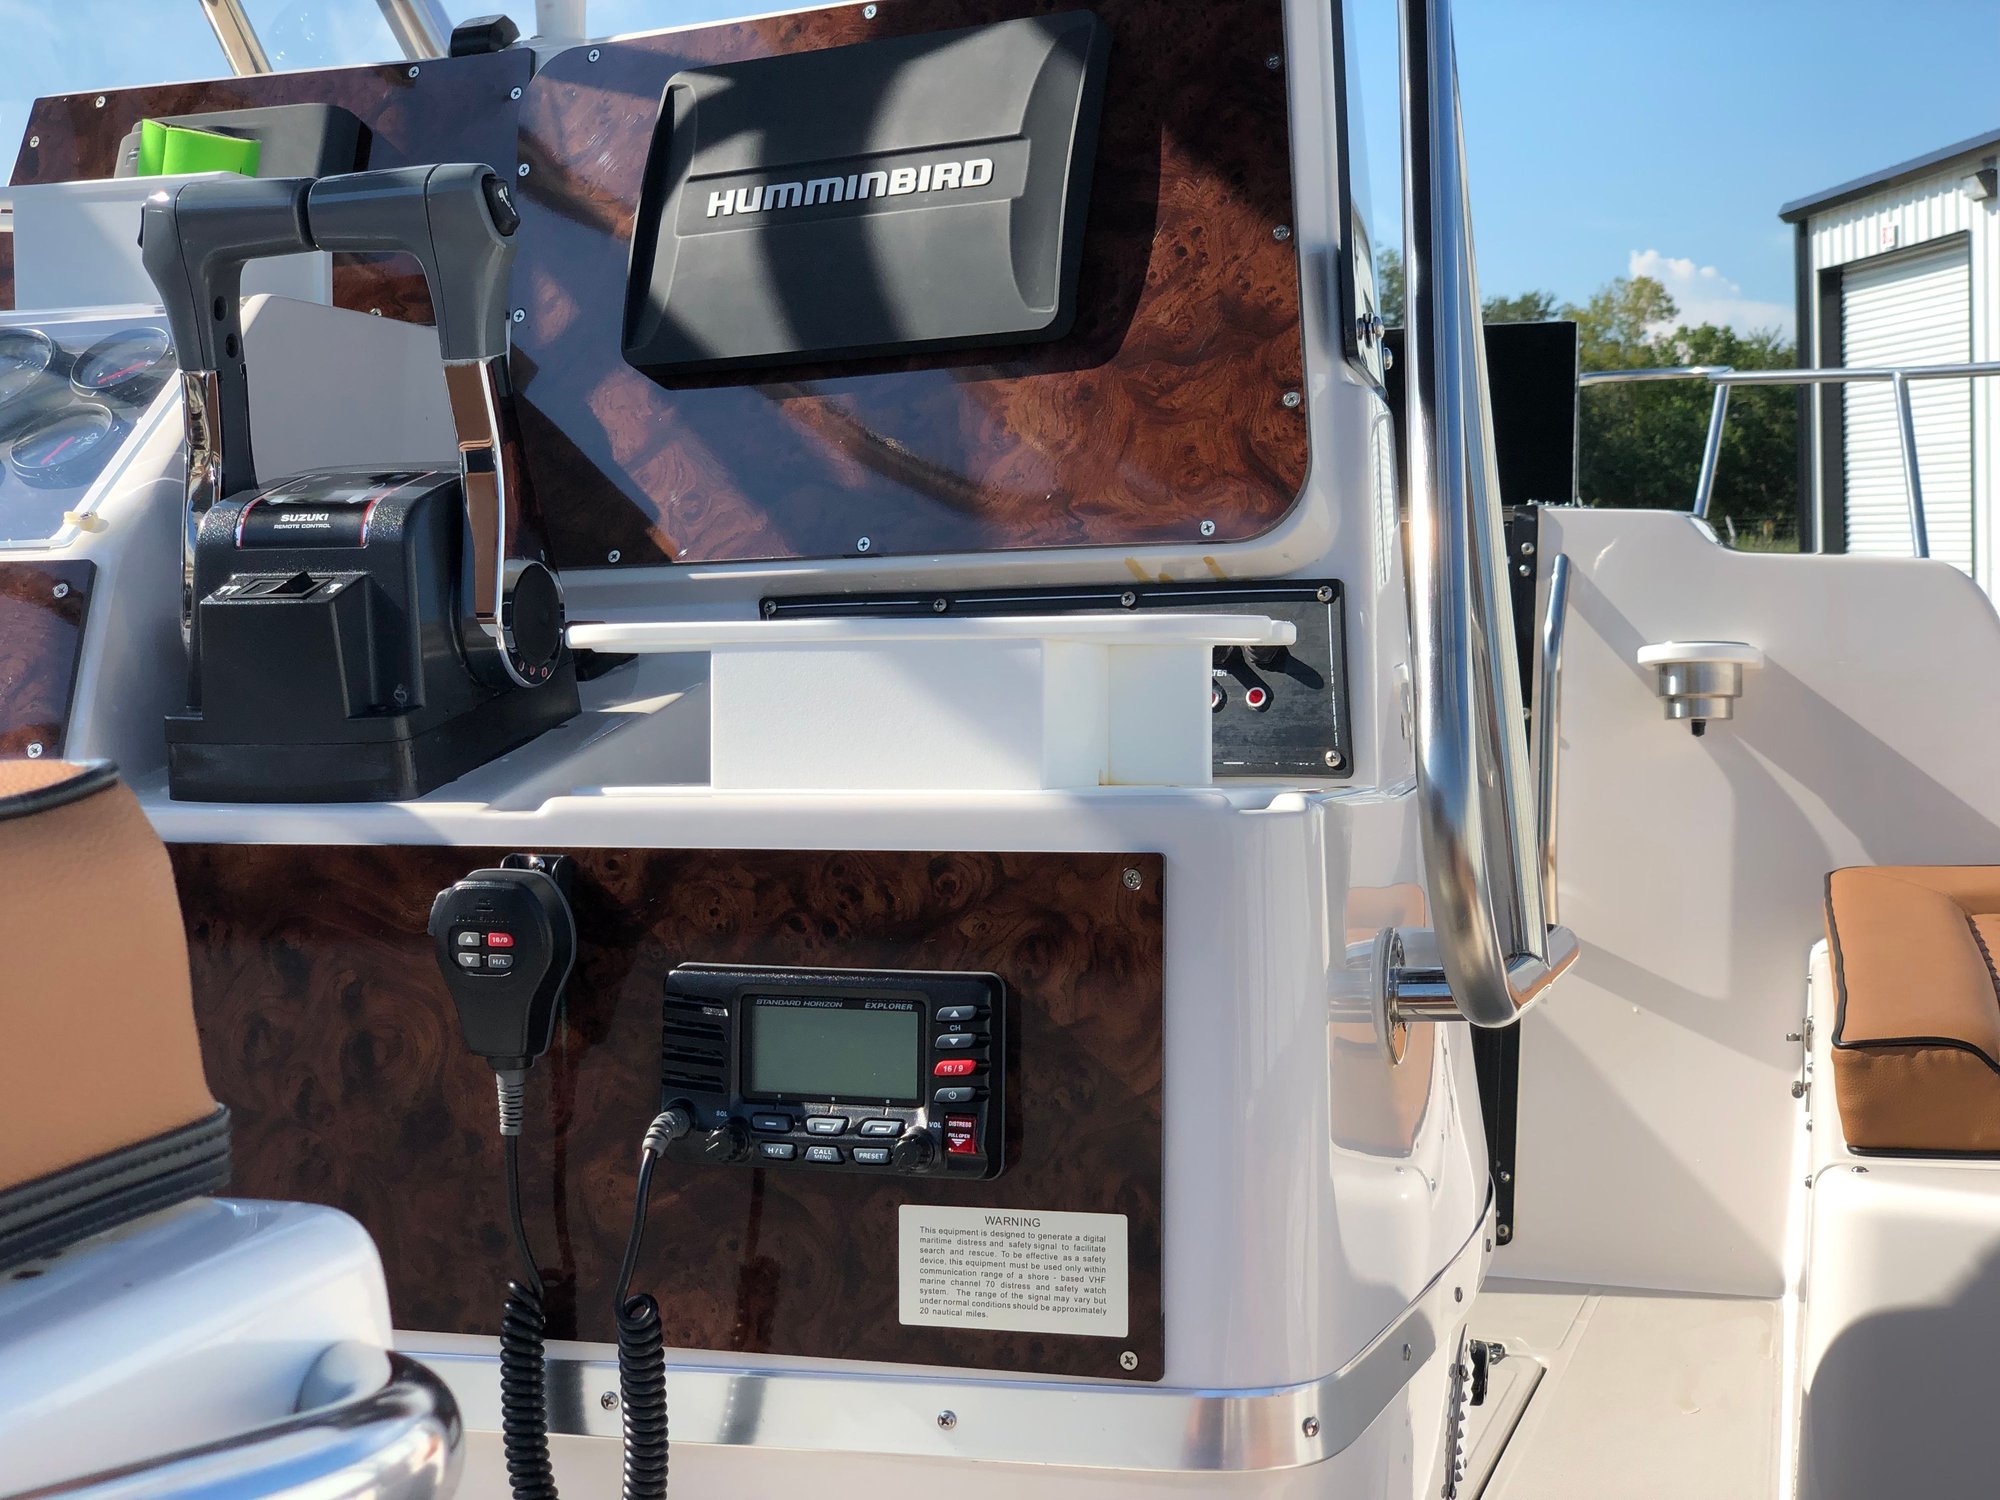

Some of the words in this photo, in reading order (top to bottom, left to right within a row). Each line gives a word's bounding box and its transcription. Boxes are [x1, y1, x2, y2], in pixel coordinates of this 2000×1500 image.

[706, 157, 995, 218] HUMMINBIRD
[280, 513, 329, 522] SUZUKI
[756, 998, 801, 1006] STANDARD
[864, 1002, 914, 1010] EXPLORER
[985, 1216, 1040, 1228] WARNING
[920, 1226, 936, 1234] This
[938, 1228, 979, 1237] equipment
[990, 1230, 1025, 1240] designed
[1038, 1233, 1072, 1241] generate
[1083, 1235, 1106, 1243] digital
[1008, 1241, 1031, 1250] safety
[1034, 1242, 1058, 1250] signal
[1074, 1244, 1106, 1252] facilitate
[1026, 1252, 1058, 1260] effective
[1082, 1256, 1106, 1264] safety
[920, 1257, 946, 1266] device,
[966, 1260, 1006, 1270] equipment
[1064, 1264, 1082, 1274] only
[920, 1267, 977, 1276] communication
[981, 1271, 1002, 1280] range
[1060, 1274, 1084, 1282] based
[950, 1279, 981, 1287] channel
[1000, 1282, 1030, 1290] distress
[1054, 1284, 1078, 1294] safety
[956, 1288, 970, 1296] The
[974, 1291, 996, 1300] range
[1028, 1294, 1050, 1302] signal
[1054, 1296, 1070, 1304] may
[1074, 1296, 1090, 1305] vary
[932, 1308, 962, 1316] nautical
[966, 1310, 988, 1318] miles.
[972, 1300, 1010, 1309] conditions
[1012, 1302, 1038, 1310] should
[1052, 1306, 1107, 1316] approximately
